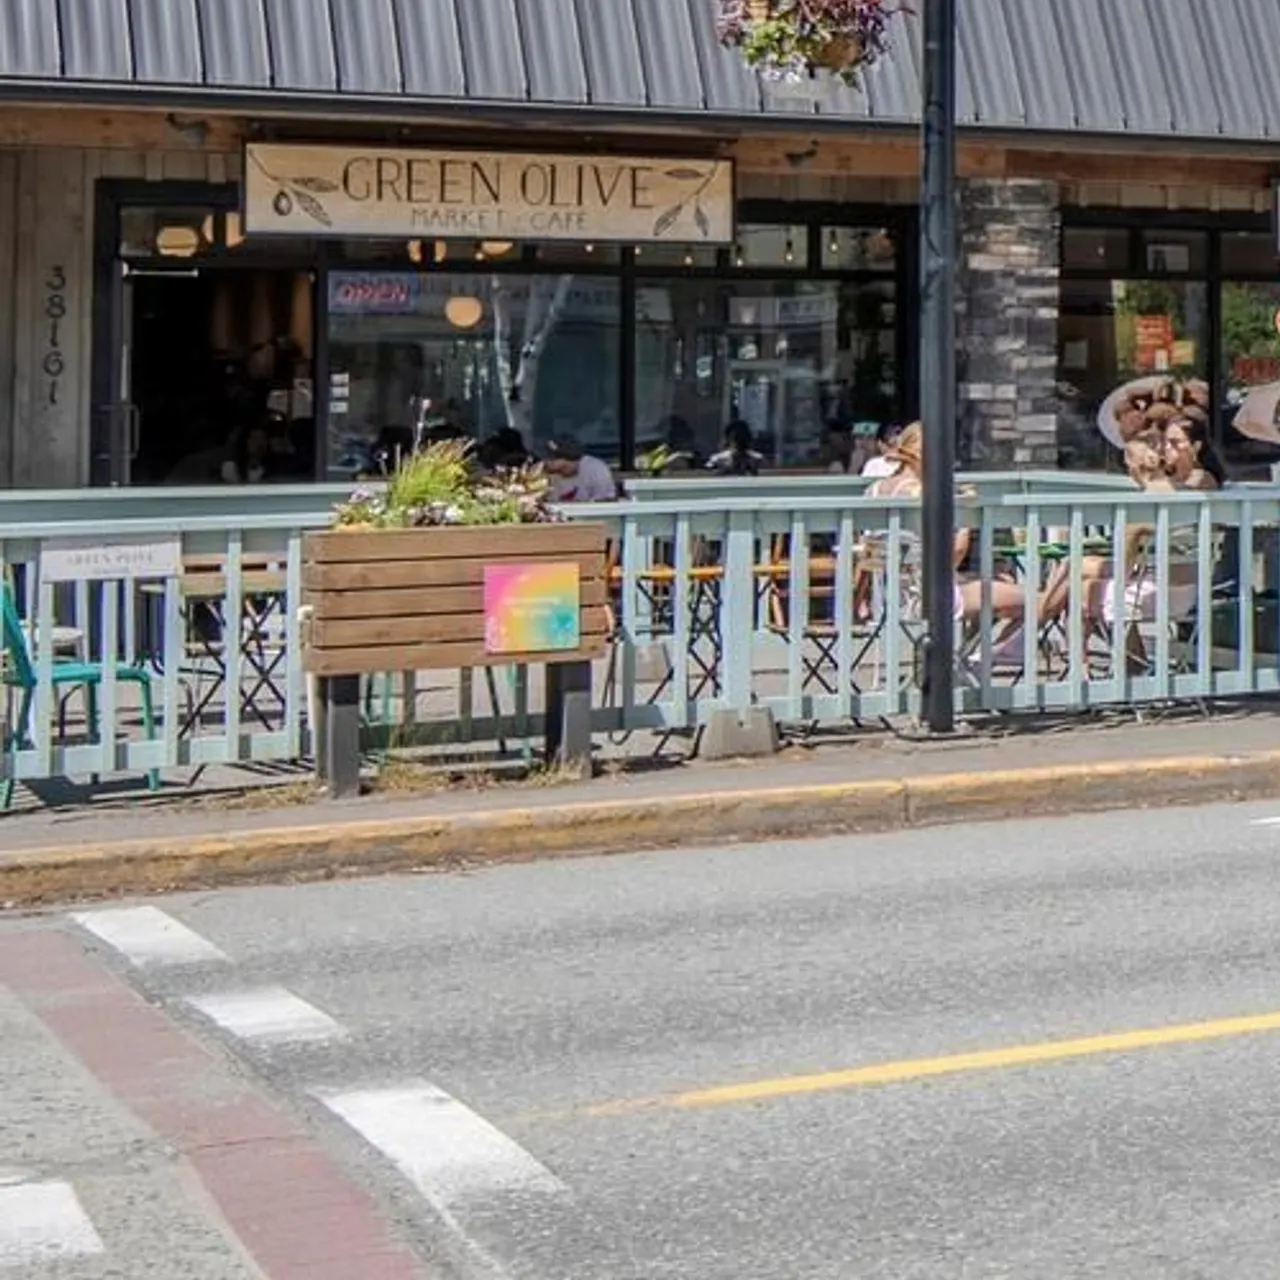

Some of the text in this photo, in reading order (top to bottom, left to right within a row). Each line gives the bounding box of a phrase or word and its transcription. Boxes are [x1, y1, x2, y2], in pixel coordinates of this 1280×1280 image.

[341, 155, 657, 210] GREEN OLIVE
[411, 208, 508, 231] MARKET
